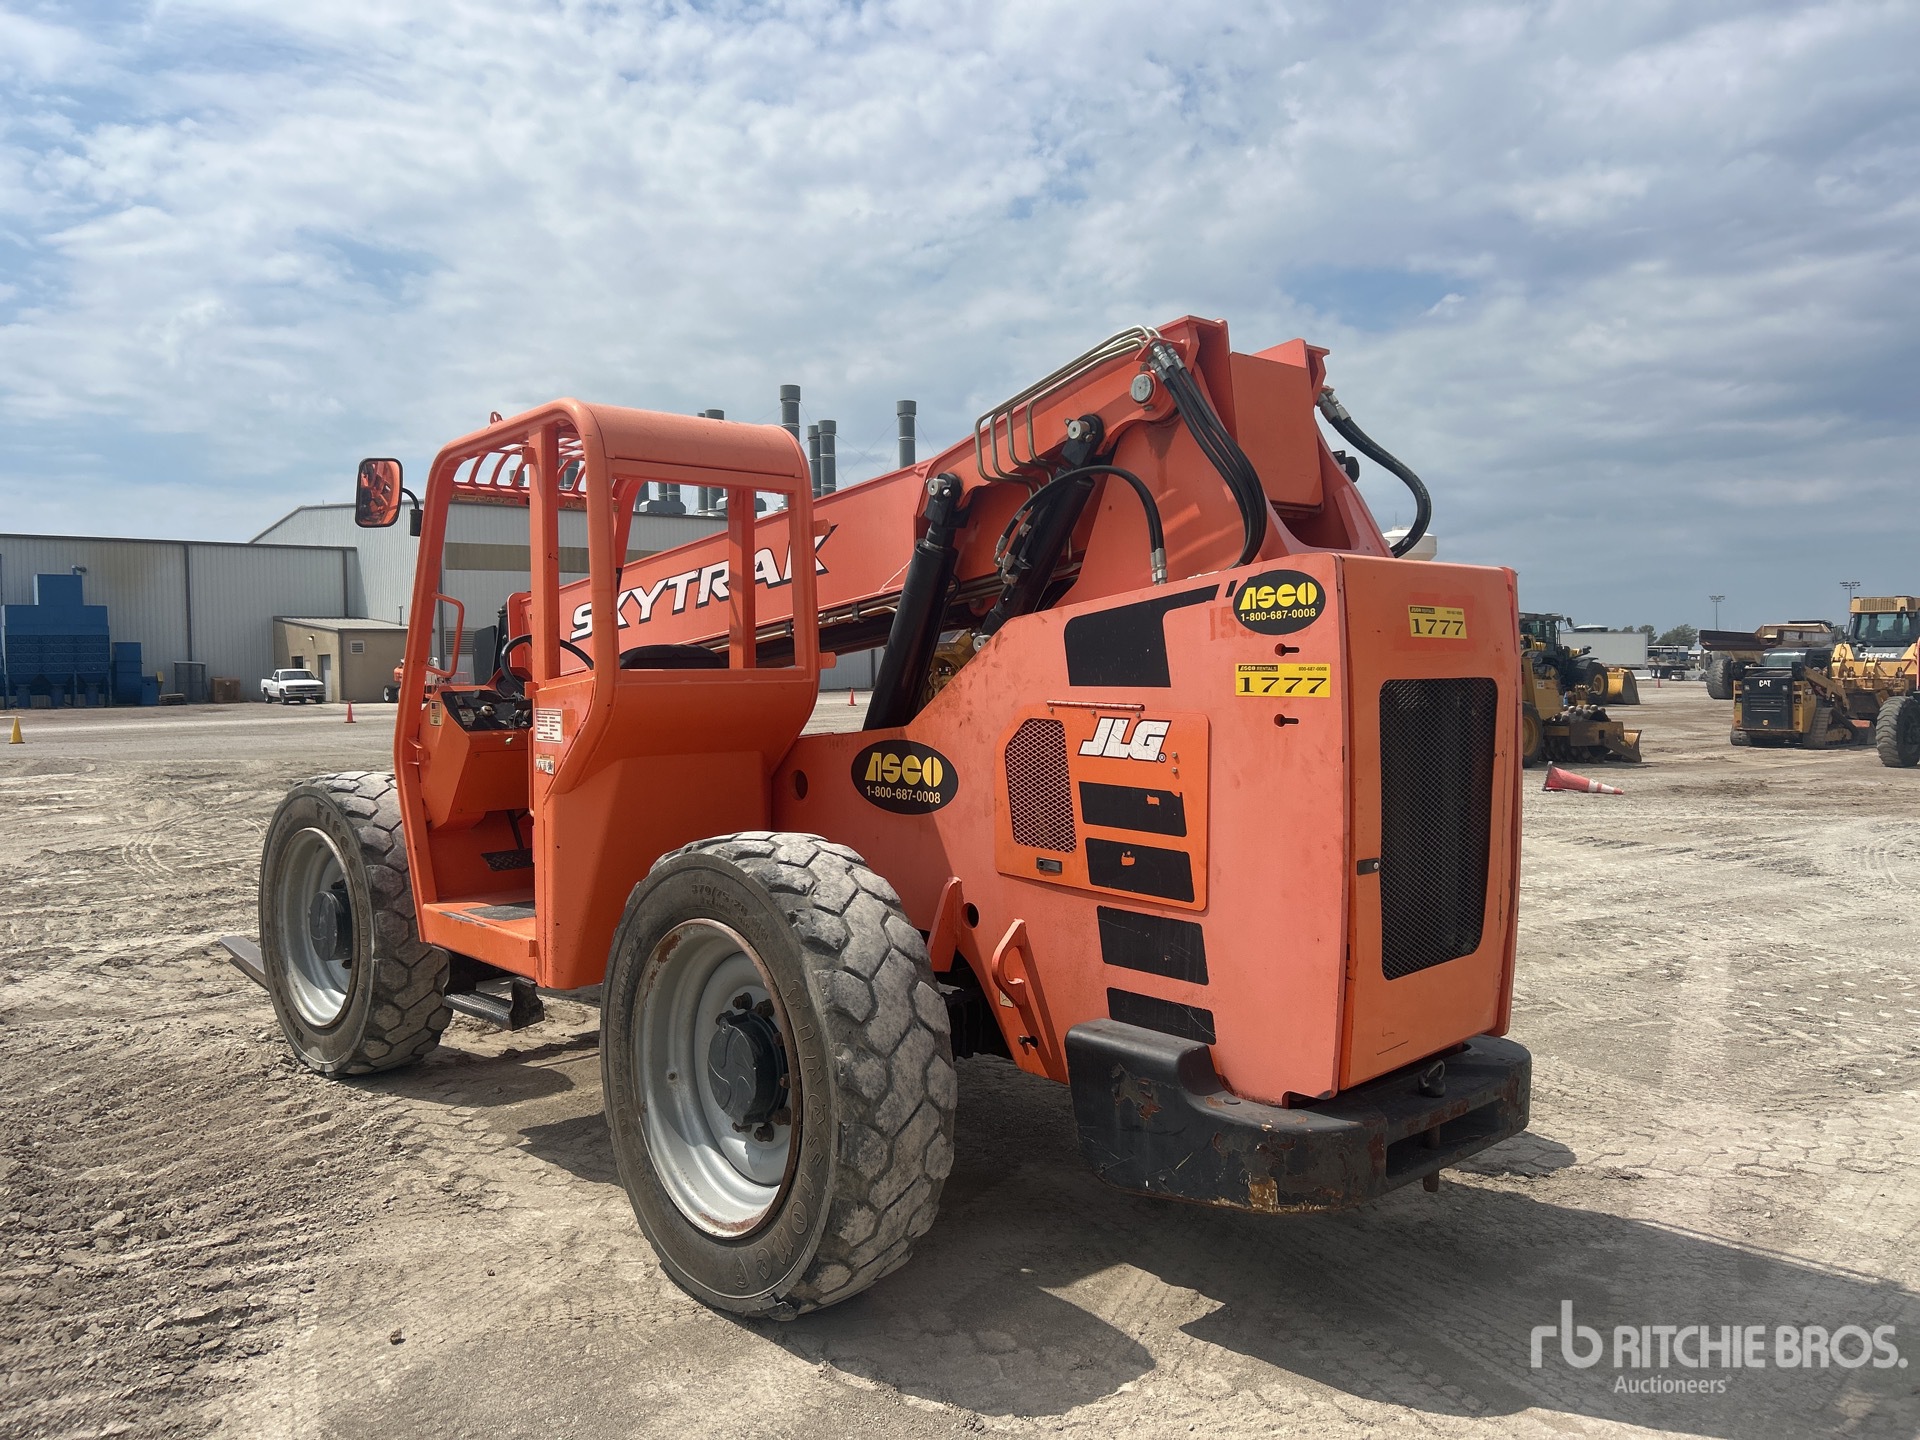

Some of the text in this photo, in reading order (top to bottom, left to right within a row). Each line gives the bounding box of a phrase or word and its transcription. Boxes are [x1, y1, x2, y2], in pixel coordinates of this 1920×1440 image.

[1239, 582, 1317, 610] ASCO
[1240, 608, 1316, 622] 1-800-687-0008
[1412, 619, 1463, 635] 1777
[1239, 677, 1327, 693] 1777
[1758, 679, 1771, 687] CAT
[1077, 716, 1172, 762] JLG
[864, 752, 943, 787] ASCO
[866, 785, 941, 804] 1-800-687-0008
